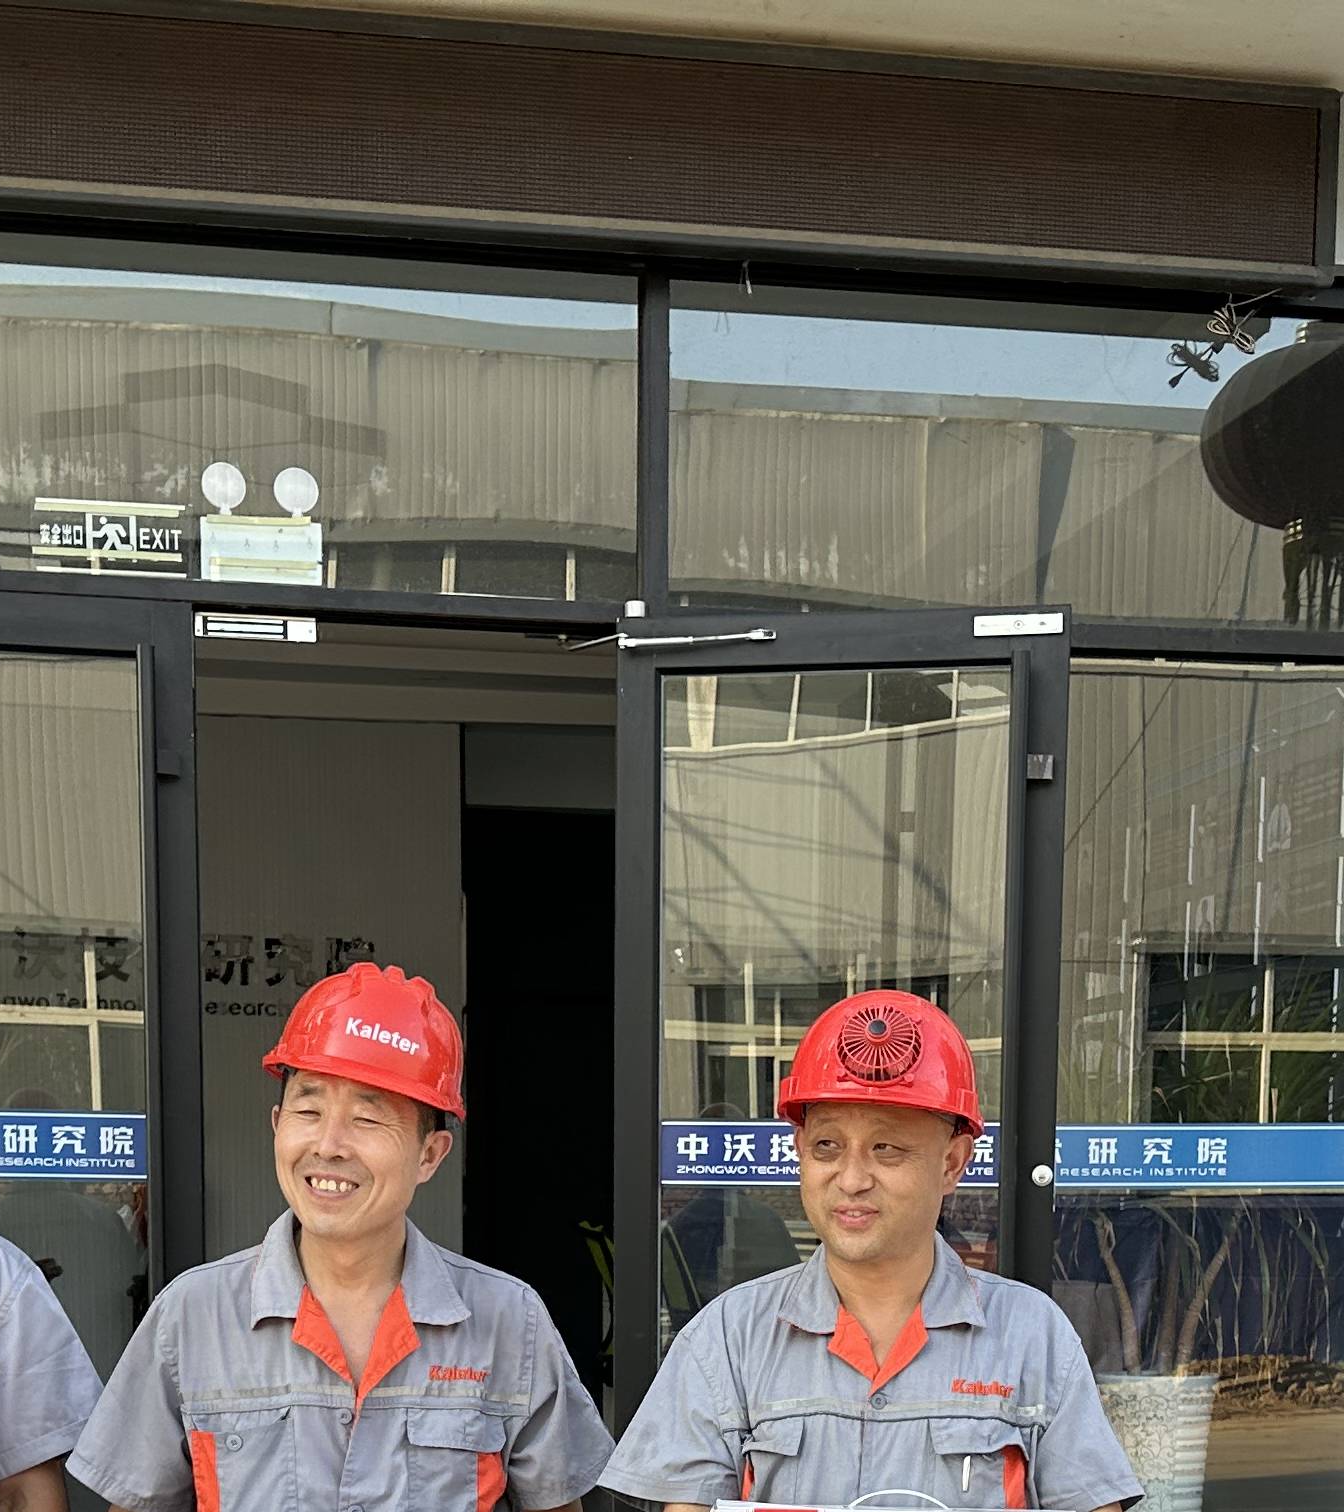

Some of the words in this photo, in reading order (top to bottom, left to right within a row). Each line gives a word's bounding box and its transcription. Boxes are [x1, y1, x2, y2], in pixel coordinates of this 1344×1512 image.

[40, 523, 83, 545] 安全出口
[139, 528, 182, 550] EXIT
[345, 1017, 420, 1056] Kaleter
[1055, 1137, 1228, 1165] 研究院
[66, 1157, 135, 1169] INSTITUTE
[676, 1165, 747, 1176] ZHONGWO
[751, 1166, 800, 1176] TECHNO
[1060, 1167, 1143, 1177] RESEARCH
[1150, 1167, 1227, 1177] INSTITUTE
